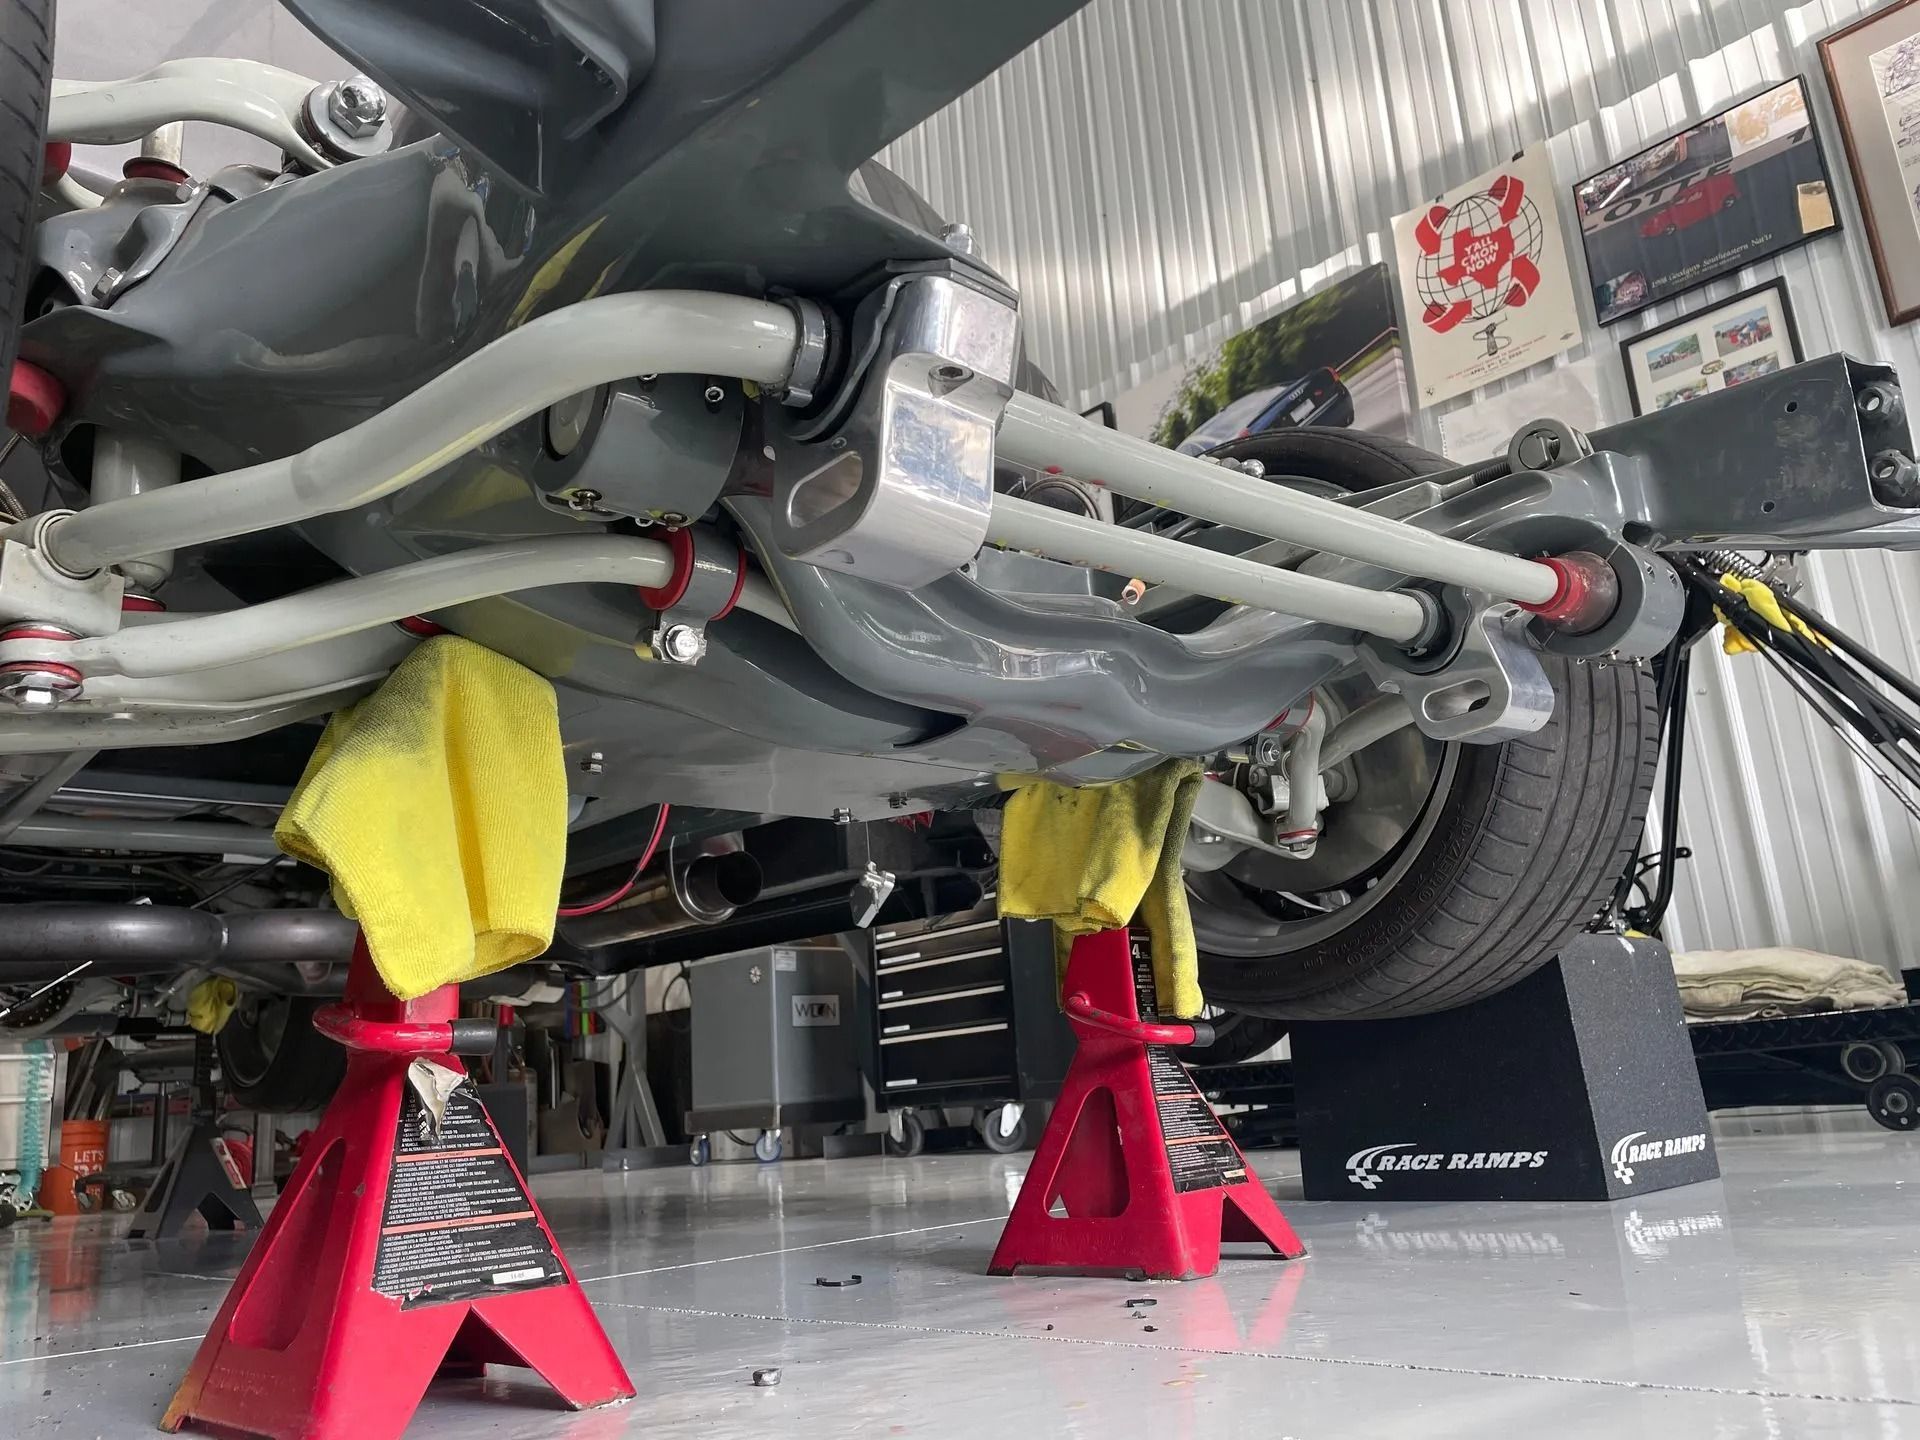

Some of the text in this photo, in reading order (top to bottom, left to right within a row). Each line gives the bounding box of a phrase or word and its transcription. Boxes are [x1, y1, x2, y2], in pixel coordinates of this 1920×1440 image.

[1466, 252, 1497, 274] NOW
[1703, 243, 1749, 266] Southeastern
[1132, 943, 1141, 959] 4
[1628, 1133, 1707, 1164] RACE RAMPS
[1376, 1150, 1548, 1171] RACE RAMPS
